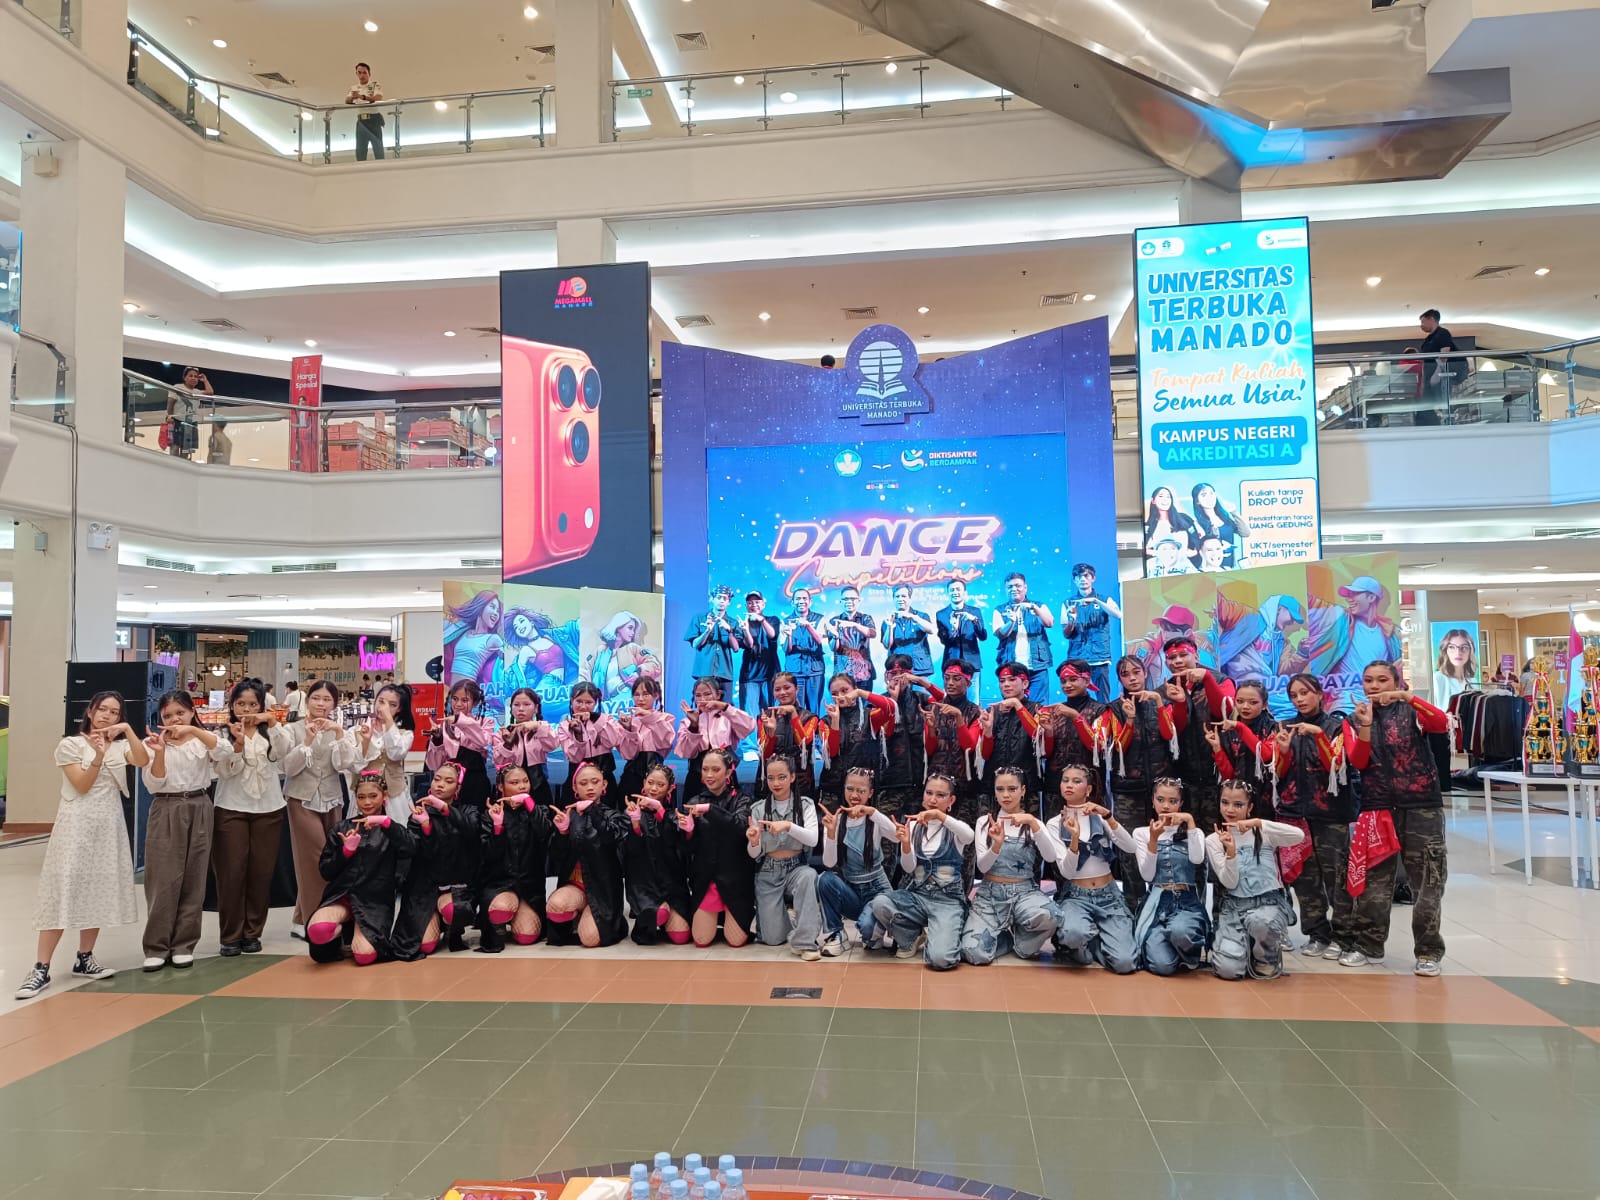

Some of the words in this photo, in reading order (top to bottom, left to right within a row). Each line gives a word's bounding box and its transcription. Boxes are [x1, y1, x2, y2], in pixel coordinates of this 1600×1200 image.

[1147, 265, 1294, 295] UNIVERSITAS
[1148, 291, 1287, 323] TERBUKA
[1150, 319, 1293, 353] MANADO
[297, 373, 316, 381] Harga
[1152, 367, 1226, 391] Tempat
[1231, 360, 1305, 384] Kuliah
[296, 381, 317, 390] Spesial
[1153, 388, 1236, 413] Semua
[1242, 378, 1307, 406] Usia!
[842, 402, 889, 411] UNIVERSITAS
[867, 411, 898, 419] MANADO
[1158, 427, 1230, 445] KAMPUS
[1233, 424, 1296, 442] NEGERI
[929, 450, 977, 459] DIKTISAINTEK
[1165, 442, 1275, 464] AKREDITASI
[1280, 442, 1295, 459] A
[1248, 489, 1275, 497] Kuliah
[1277, 488, 1304, 497] tanpa
[1247, 497, 1278, 506] DROP
[1280, 496, 1303, 505] OUT
[1249, 522, 1274, 530] UANG
[1275, 520, 1314, 529] GEDUNG
[772, 517, 994, 561] DANCE
[1249, 540, 1314, 550] UKT/semester
[1250, 550, 1278, 558] mulai
